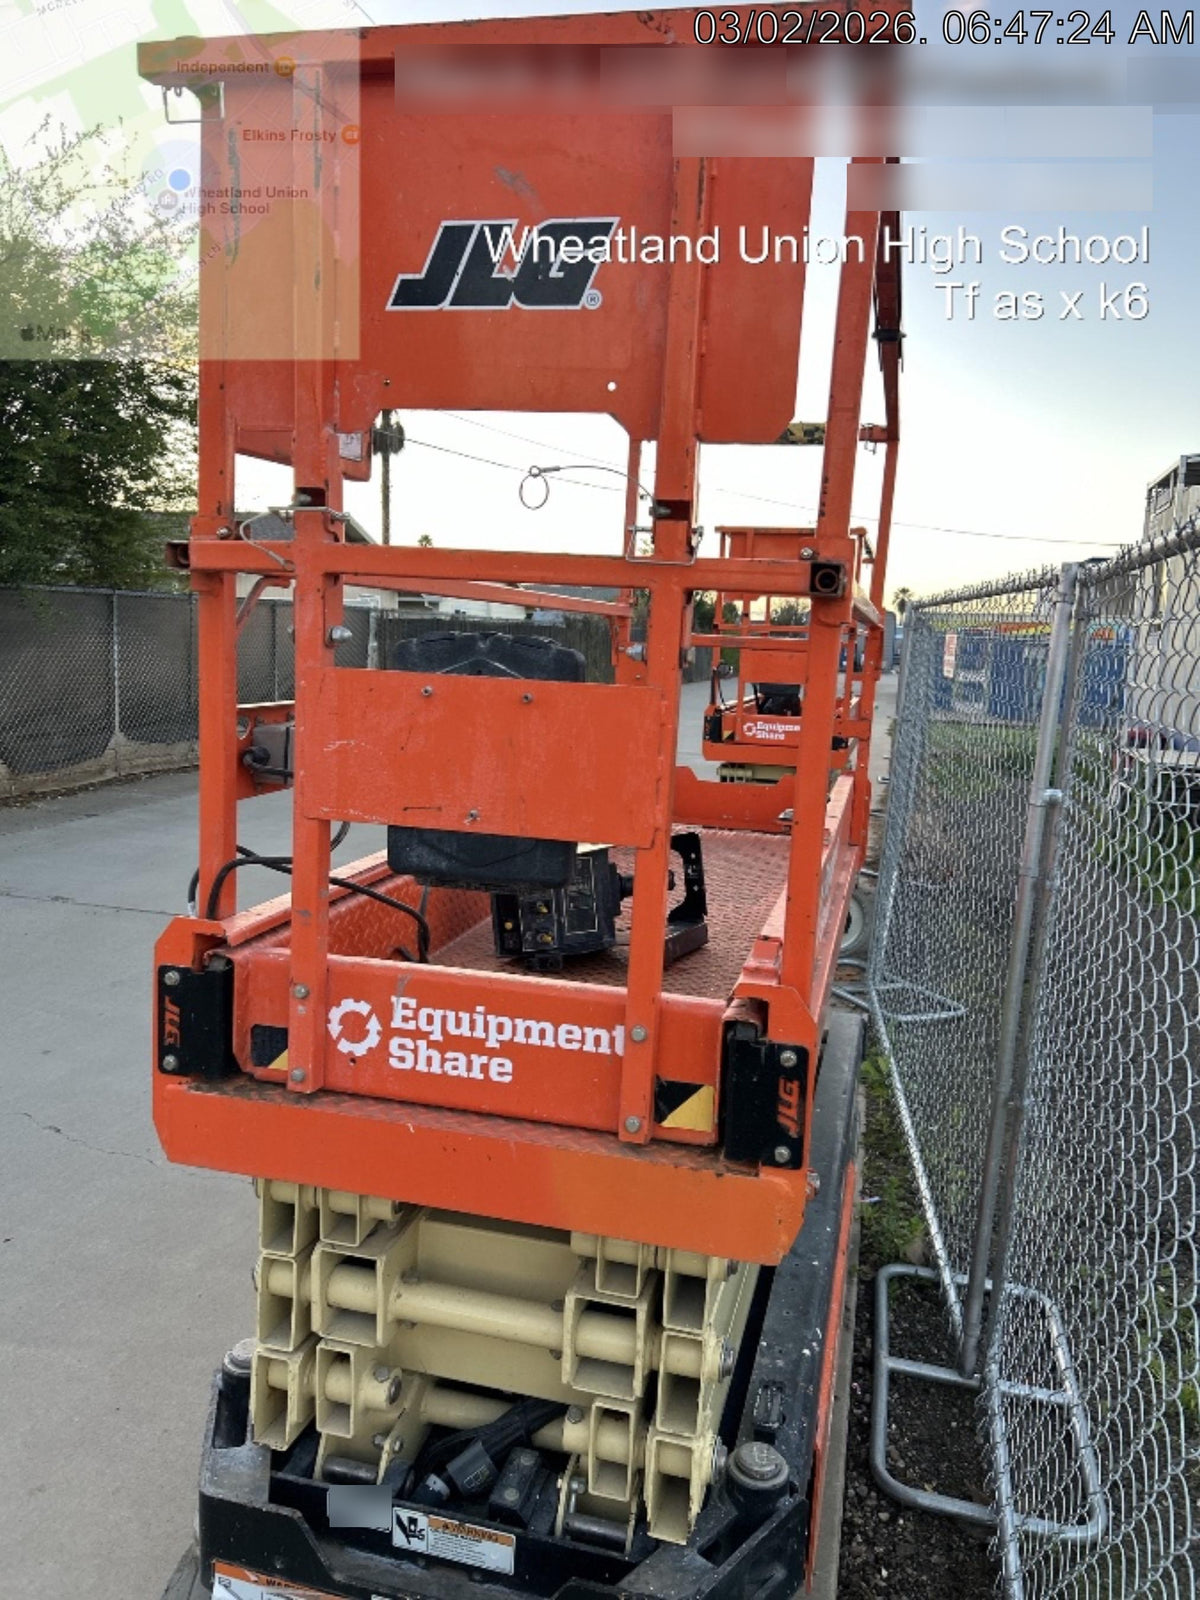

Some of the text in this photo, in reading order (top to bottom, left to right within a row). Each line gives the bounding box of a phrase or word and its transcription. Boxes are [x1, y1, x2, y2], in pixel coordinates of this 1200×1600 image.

[385, 217, 621, 311] JLG
[756, 730, 786, 741] Share
[164, 995, 181, 1048] JLG
[390, 995, 626, 1057] Equipment
[388, 1035, 513, 1083] Share
[777, 1076, 800, 1139] JLG
